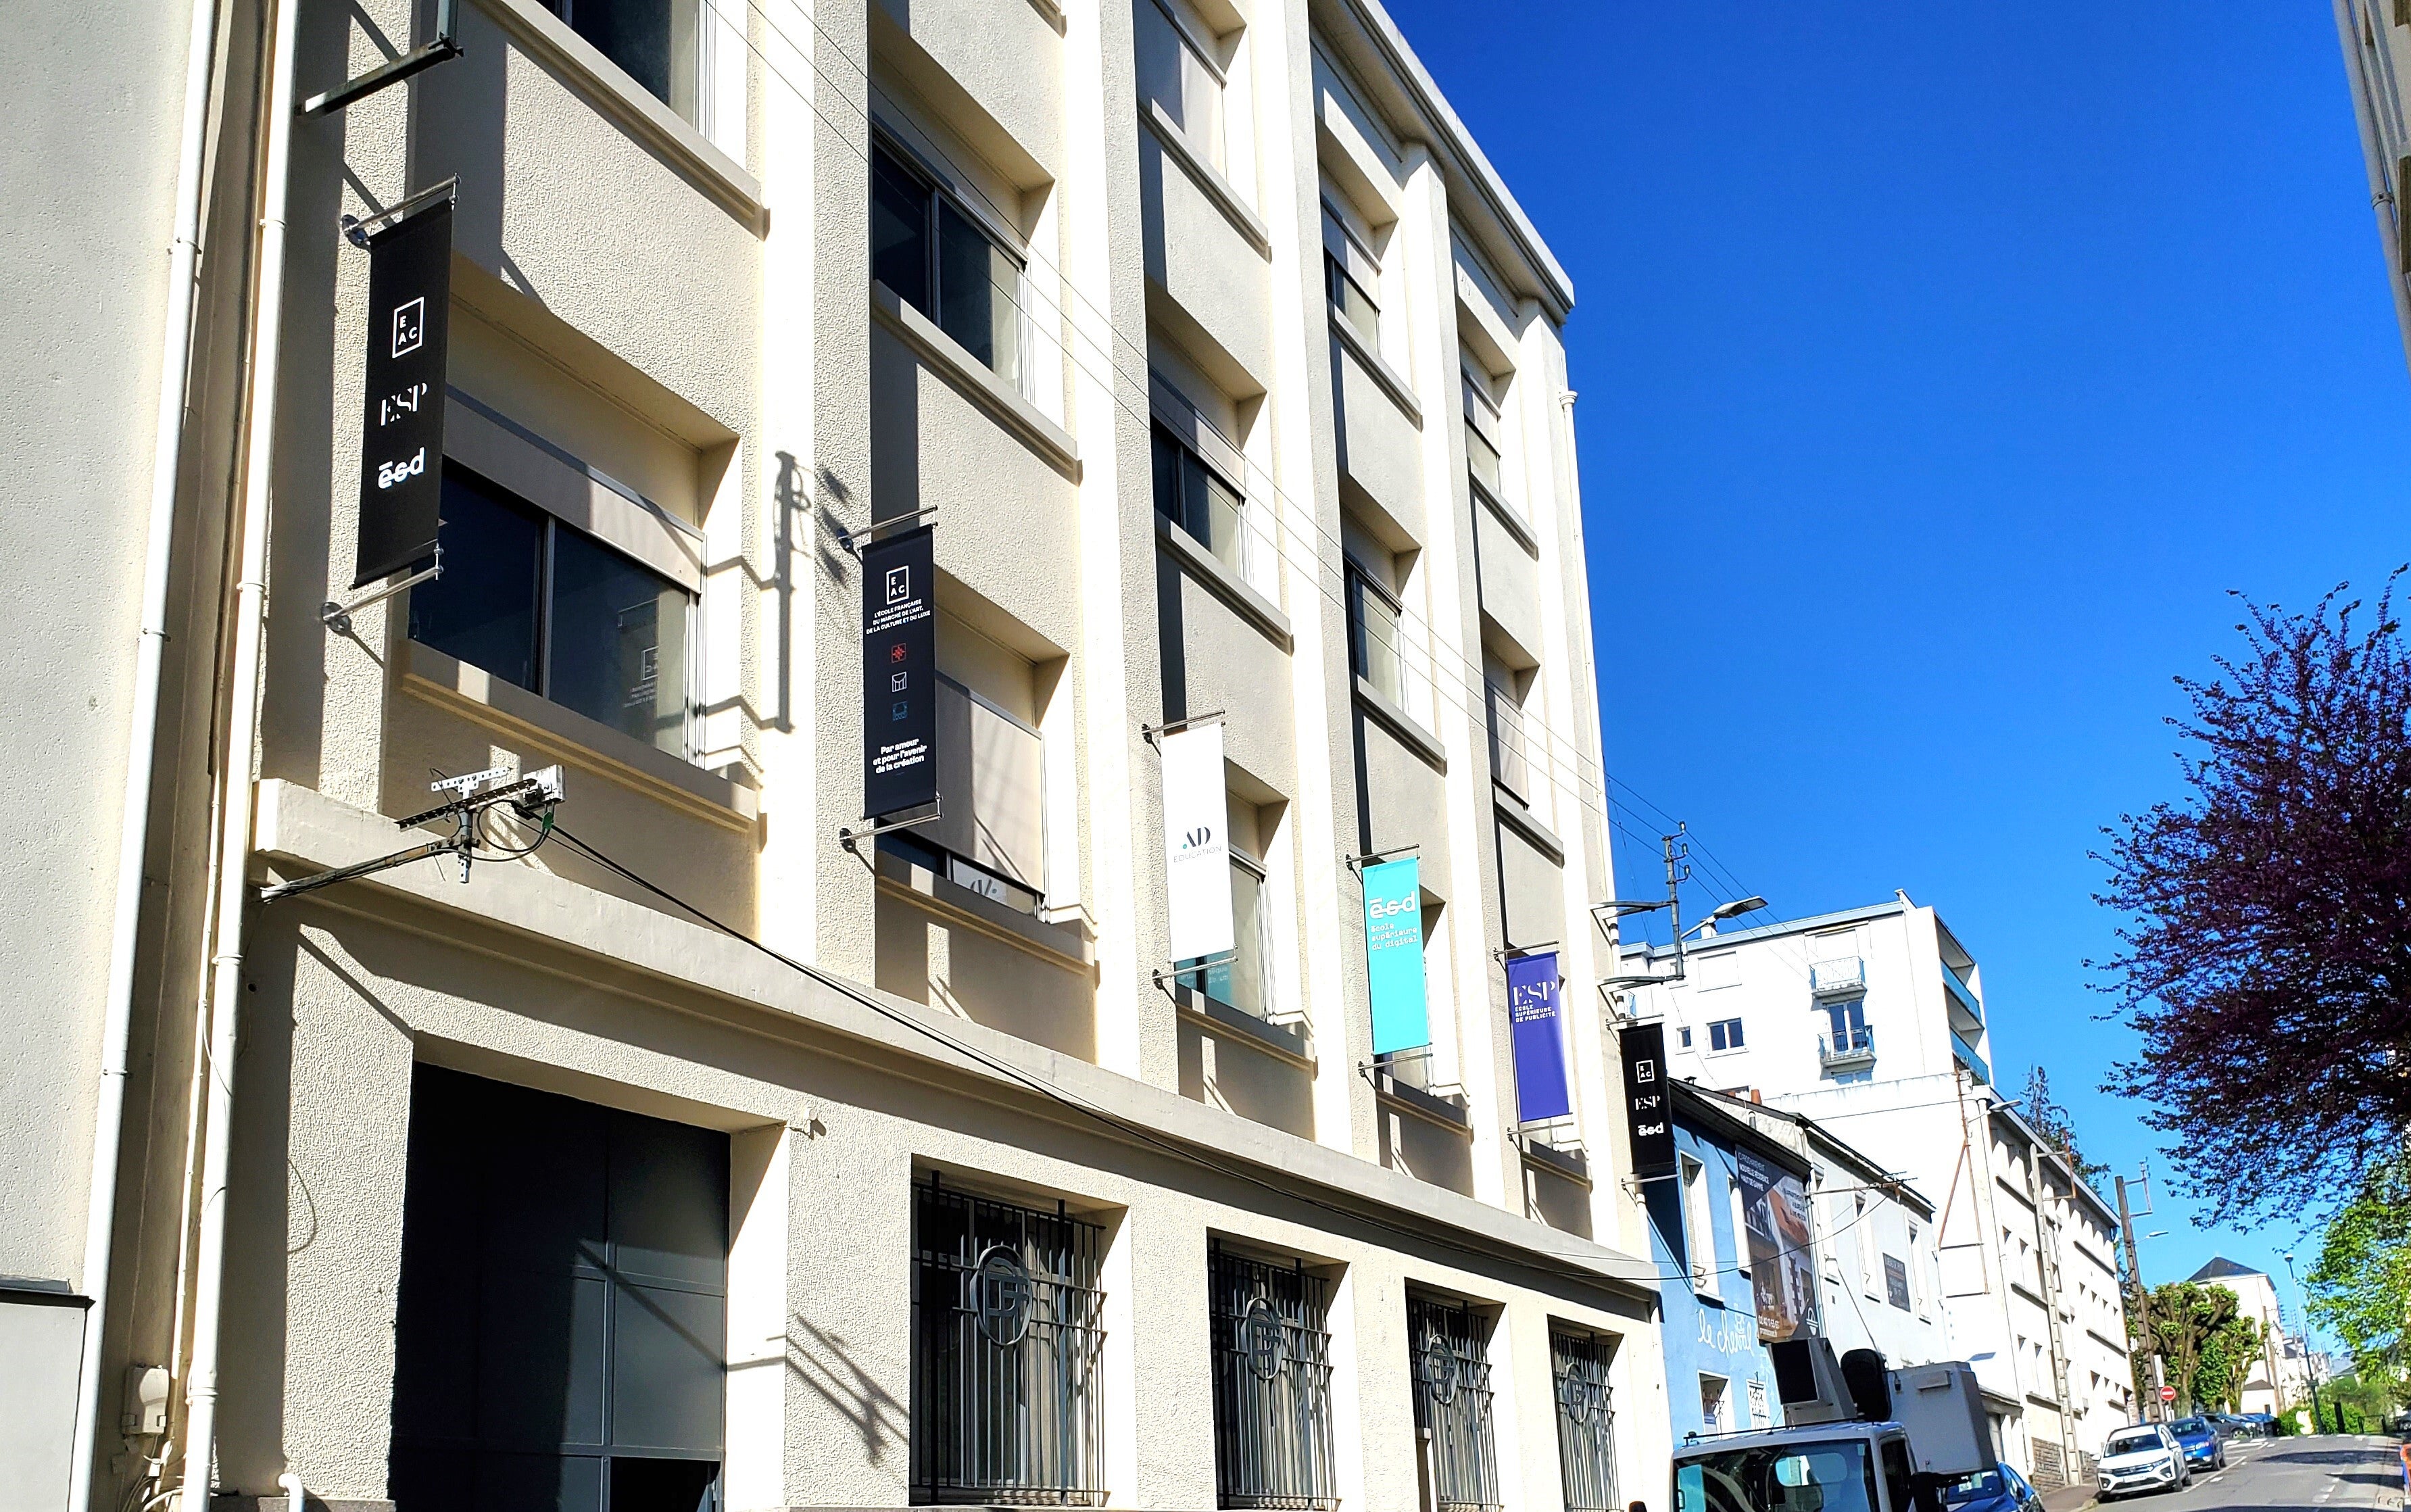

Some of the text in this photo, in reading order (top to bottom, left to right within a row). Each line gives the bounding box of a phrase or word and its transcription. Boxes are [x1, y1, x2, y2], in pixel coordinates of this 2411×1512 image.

[381, 383, 428, 426] ESP
[874, 599, 922, 618] L'ÉCOLE FRANÇAISE
[881, 612, 901, 623] MARCHÉ
[881, 619, 902, 630] CULTURE
[917, 610, 931, 618] LUXE
[873, 744, 927, 766] et pour l'avenir
[881, 738, 919, 754] Par amour
[875, 755, 925, 773] de la création
[1182, 827, 1211, 850] AD
[1173, 845, 1222, 862] EDUCATION
[1371, 935, 1417, 951] du digital
[1513, 981, 1555, 1006] ESP
[1525, 1010, 1556, 1021] PUBLICITÉ
[1635, 1095, 1661, 1111] ESP
[1697, 1308, 1755, 1359] le cheval
